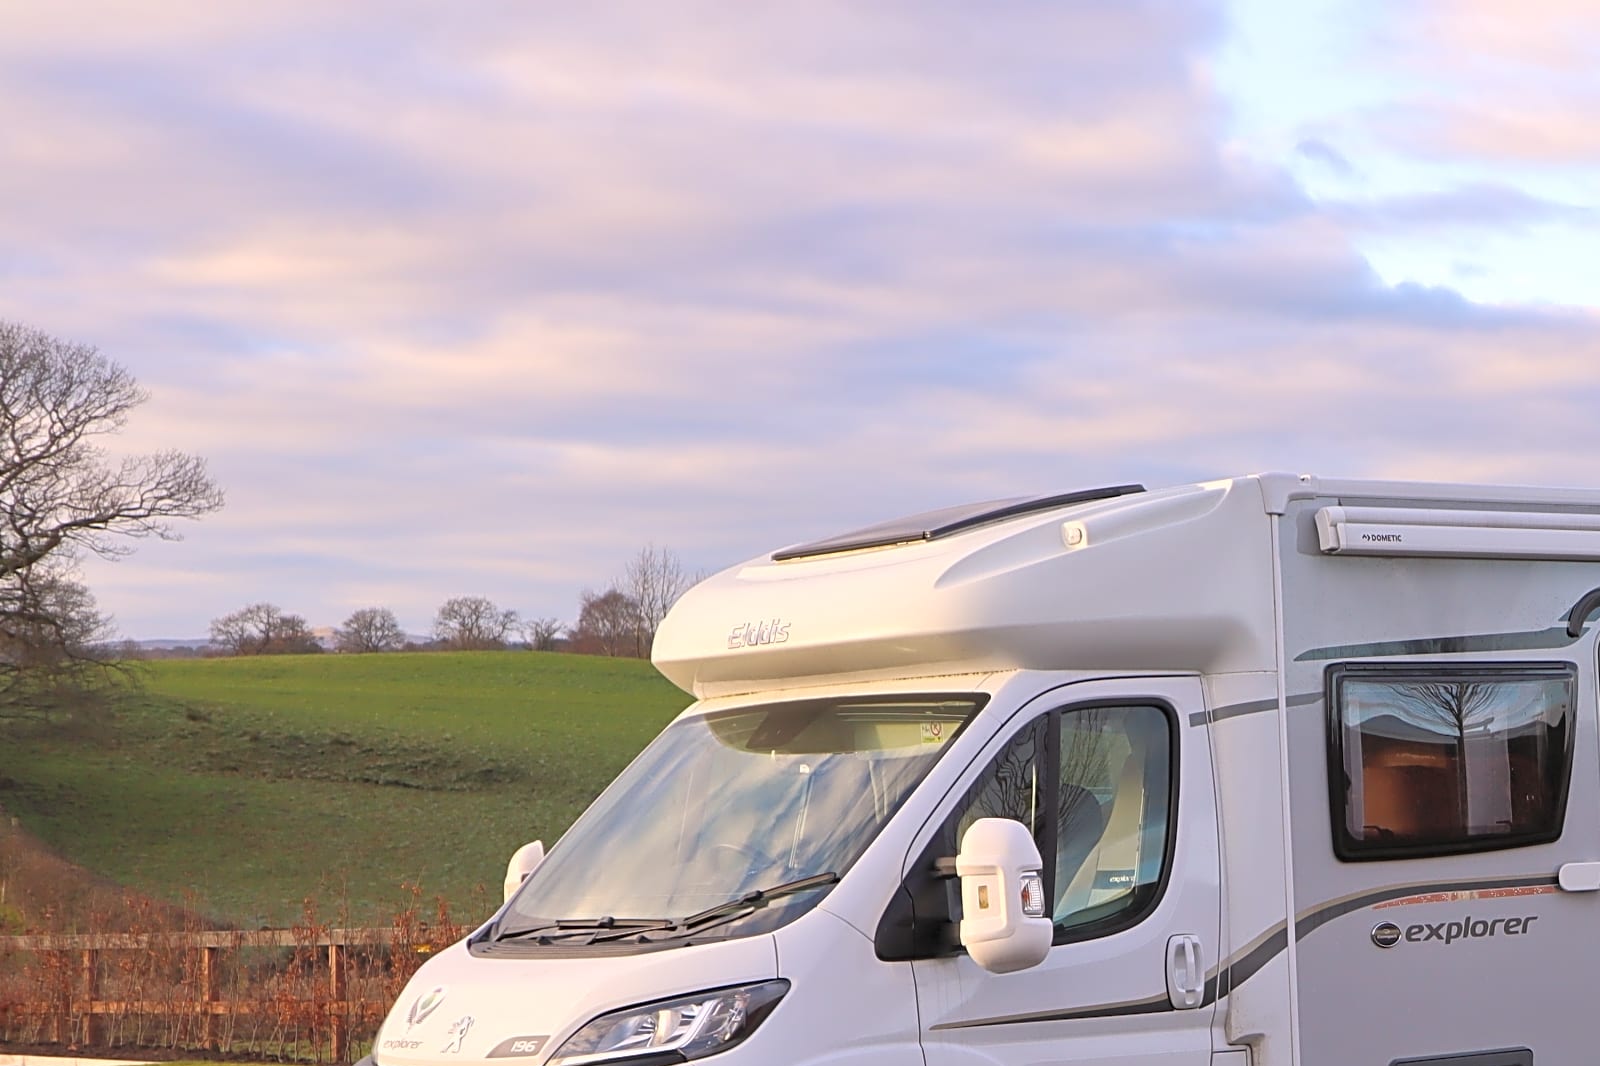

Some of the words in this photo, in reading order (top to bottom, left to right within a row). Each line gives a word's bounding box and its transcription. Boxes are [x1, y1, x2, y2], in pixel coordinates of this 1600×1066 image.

[1371, 534, 1402, 543] DOMETIC
[727, 618, 792, 650] Elddis
[1405, 915, 1539, 945] explorer
[510, 1040, 539, 1053] 196
